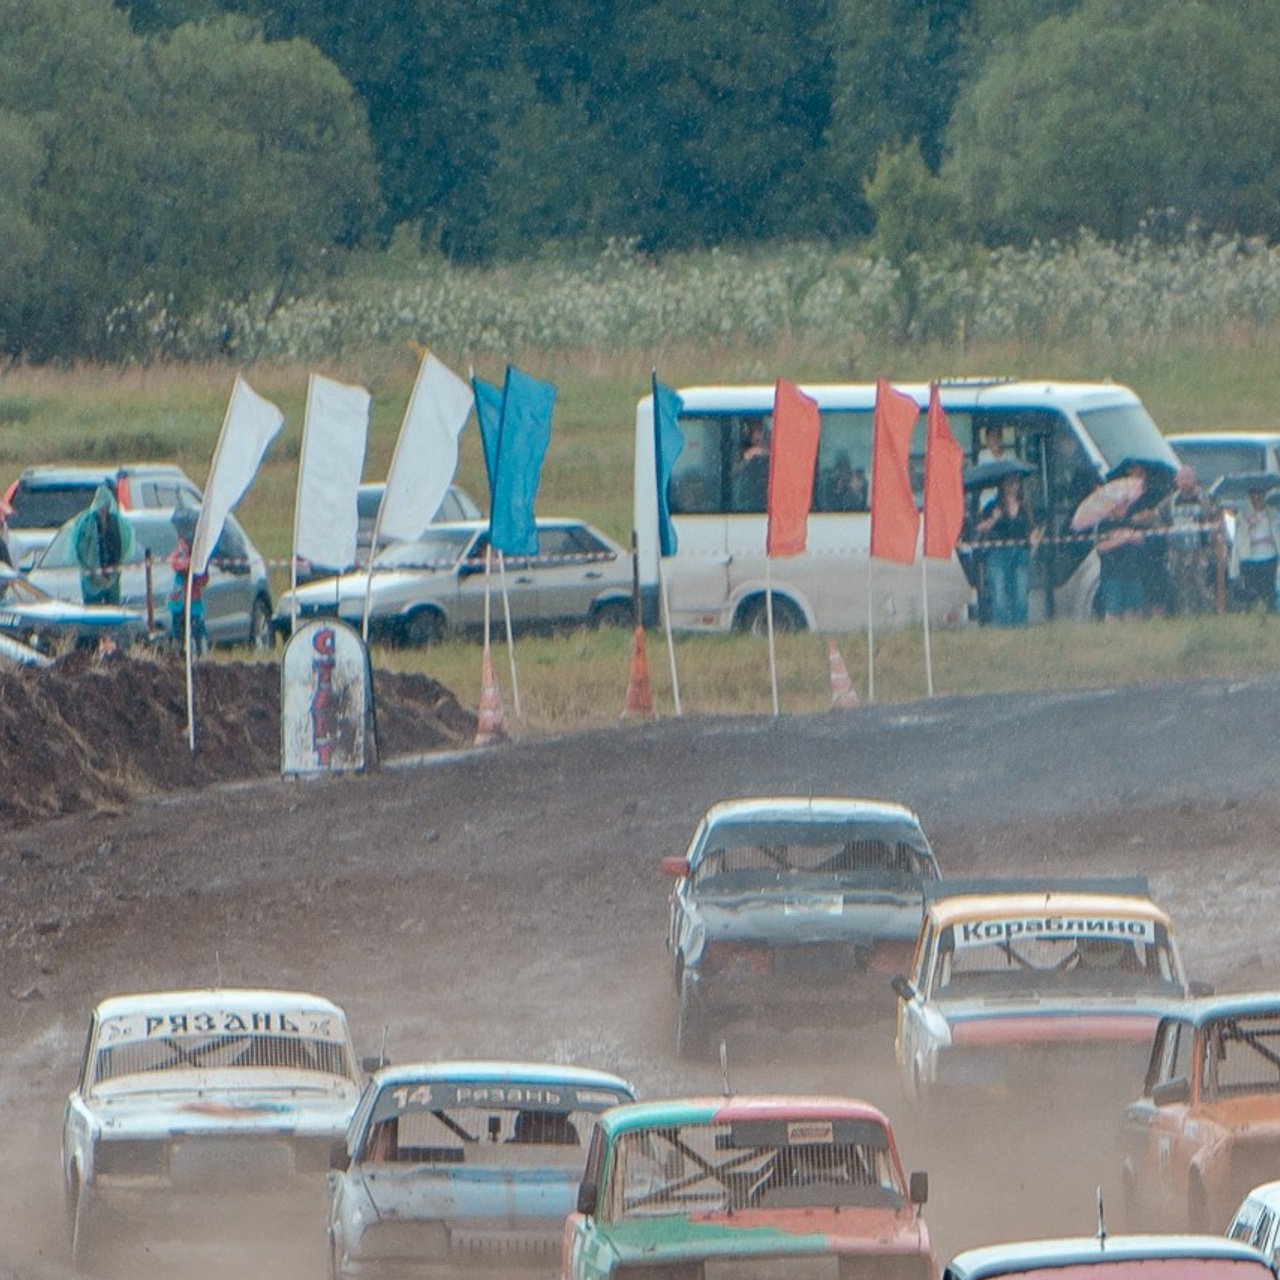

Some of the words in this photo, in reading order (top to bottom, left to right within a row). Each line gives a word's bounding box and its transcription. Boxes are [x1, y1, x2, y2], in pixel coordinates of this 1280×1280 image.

[963, 917, 1147, 942] Кораблино
[146, 1012, 299, 1036] РЯЗАНЬ
[392, 1084, 433, 1109] 14
